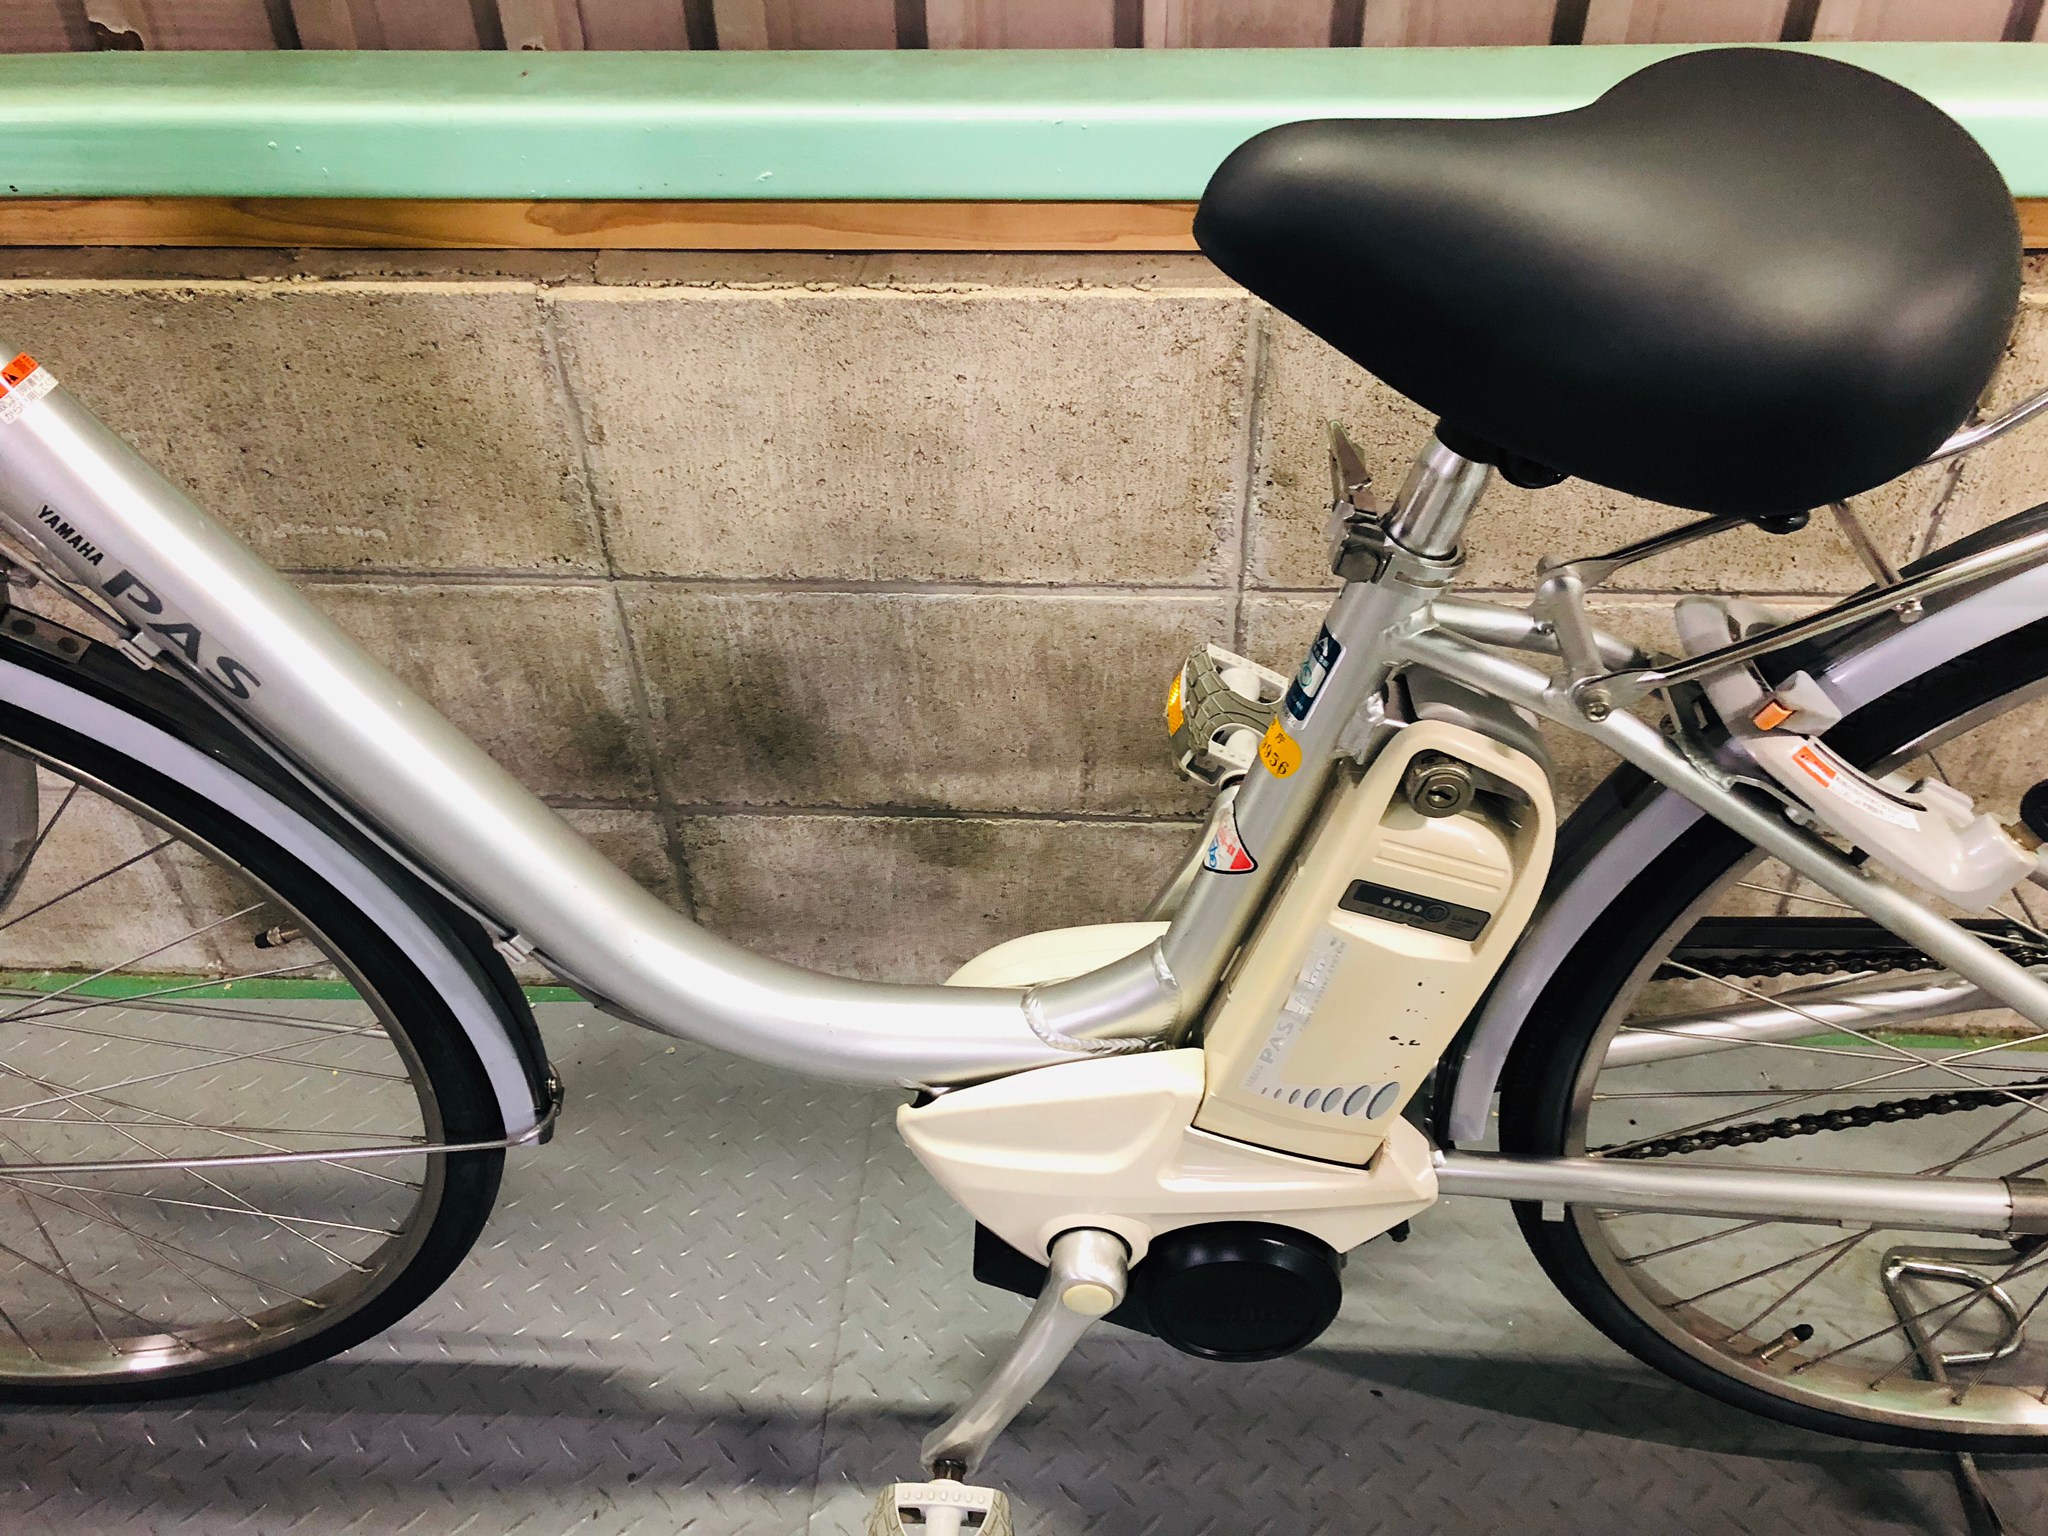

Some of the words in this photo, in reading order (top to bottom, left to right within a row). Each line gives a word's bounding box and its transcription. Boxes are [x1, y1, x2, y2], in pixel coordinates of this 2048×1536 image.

[37, 505, 104, 567] YAMAHA
[102, 569, 261, 699] PAS
[1259, 1021, 1294, 1064] PAS
